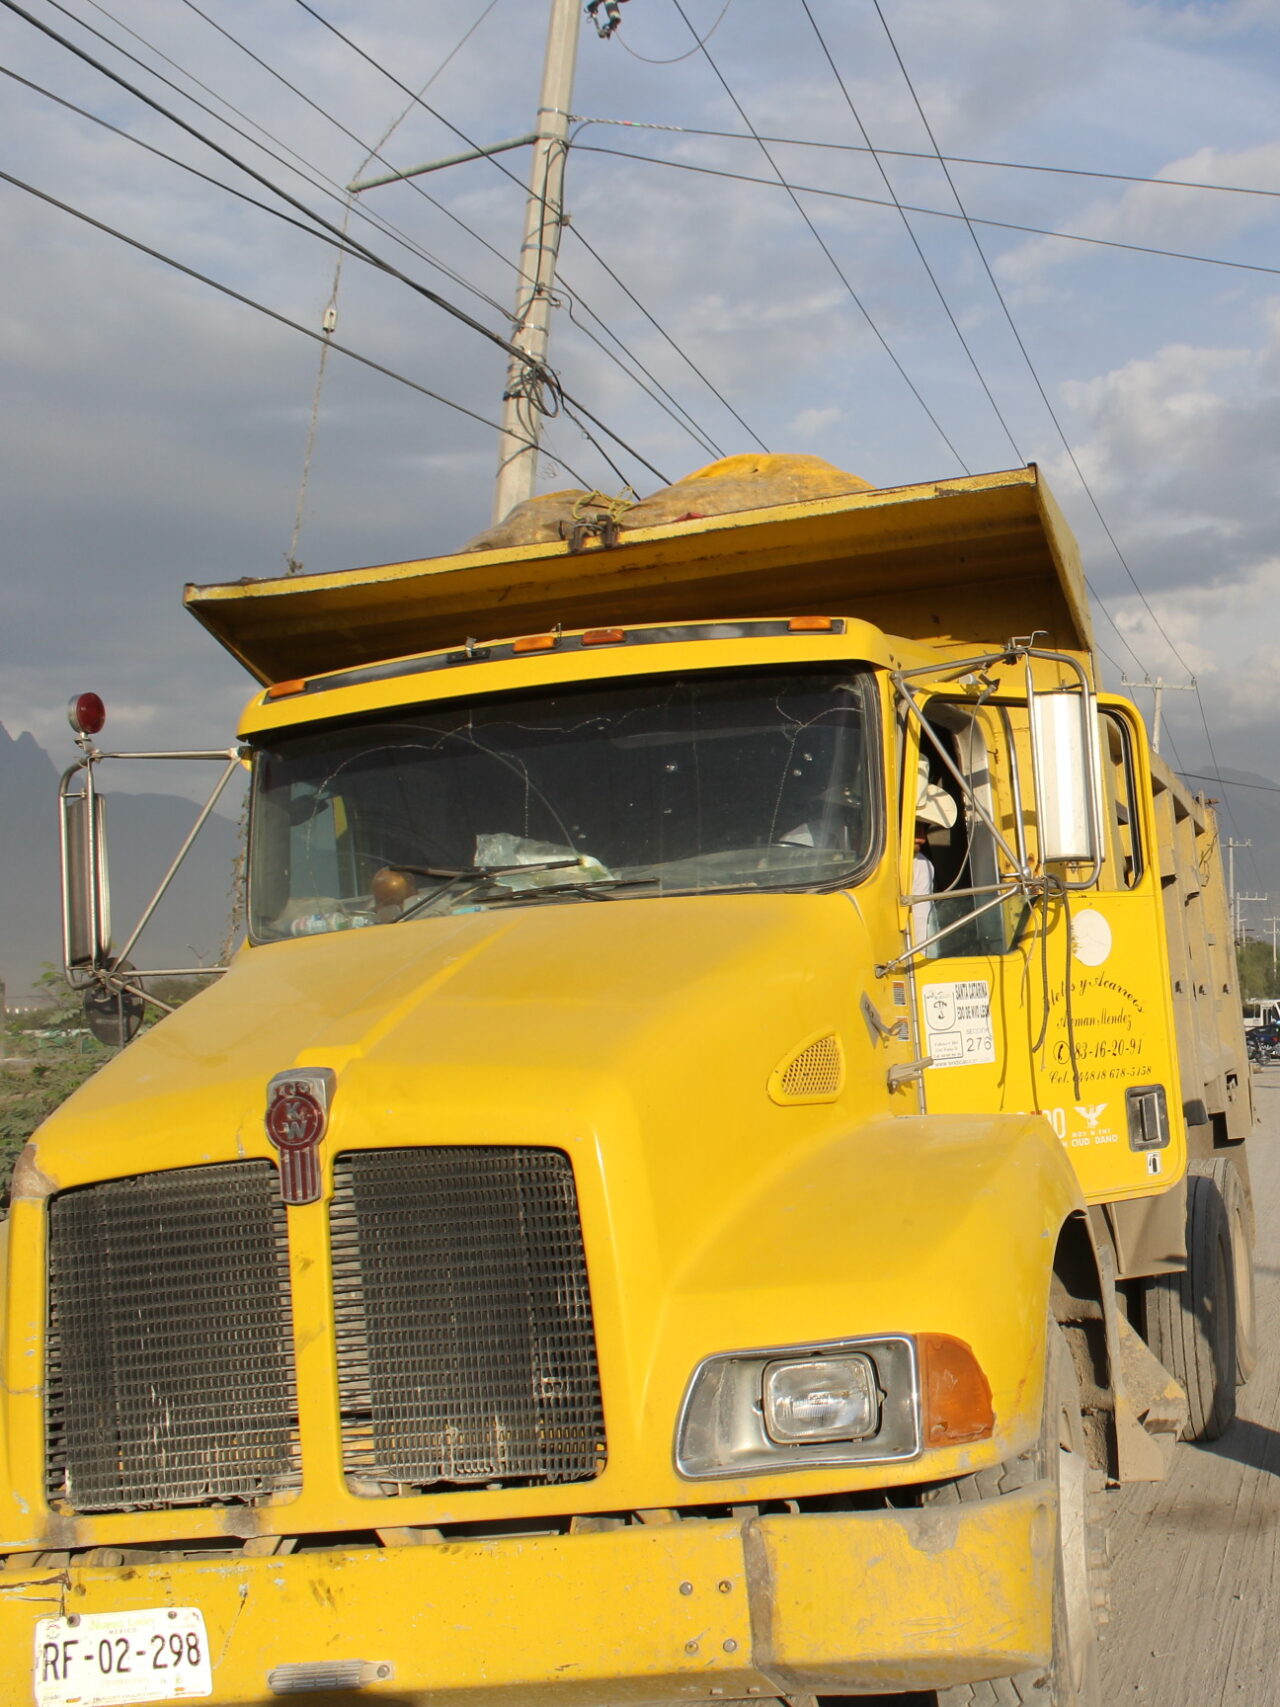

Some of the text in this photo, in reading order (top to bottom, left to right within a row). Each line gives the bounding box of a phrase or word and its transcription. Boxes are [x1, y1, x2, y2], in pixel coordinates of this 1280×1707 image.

[966, 1036, 992, 1052] 276
[1074, 1038, 1144, 1060] 83-16-20-91
[43, 1632, 201, 1682] RF-02-298
